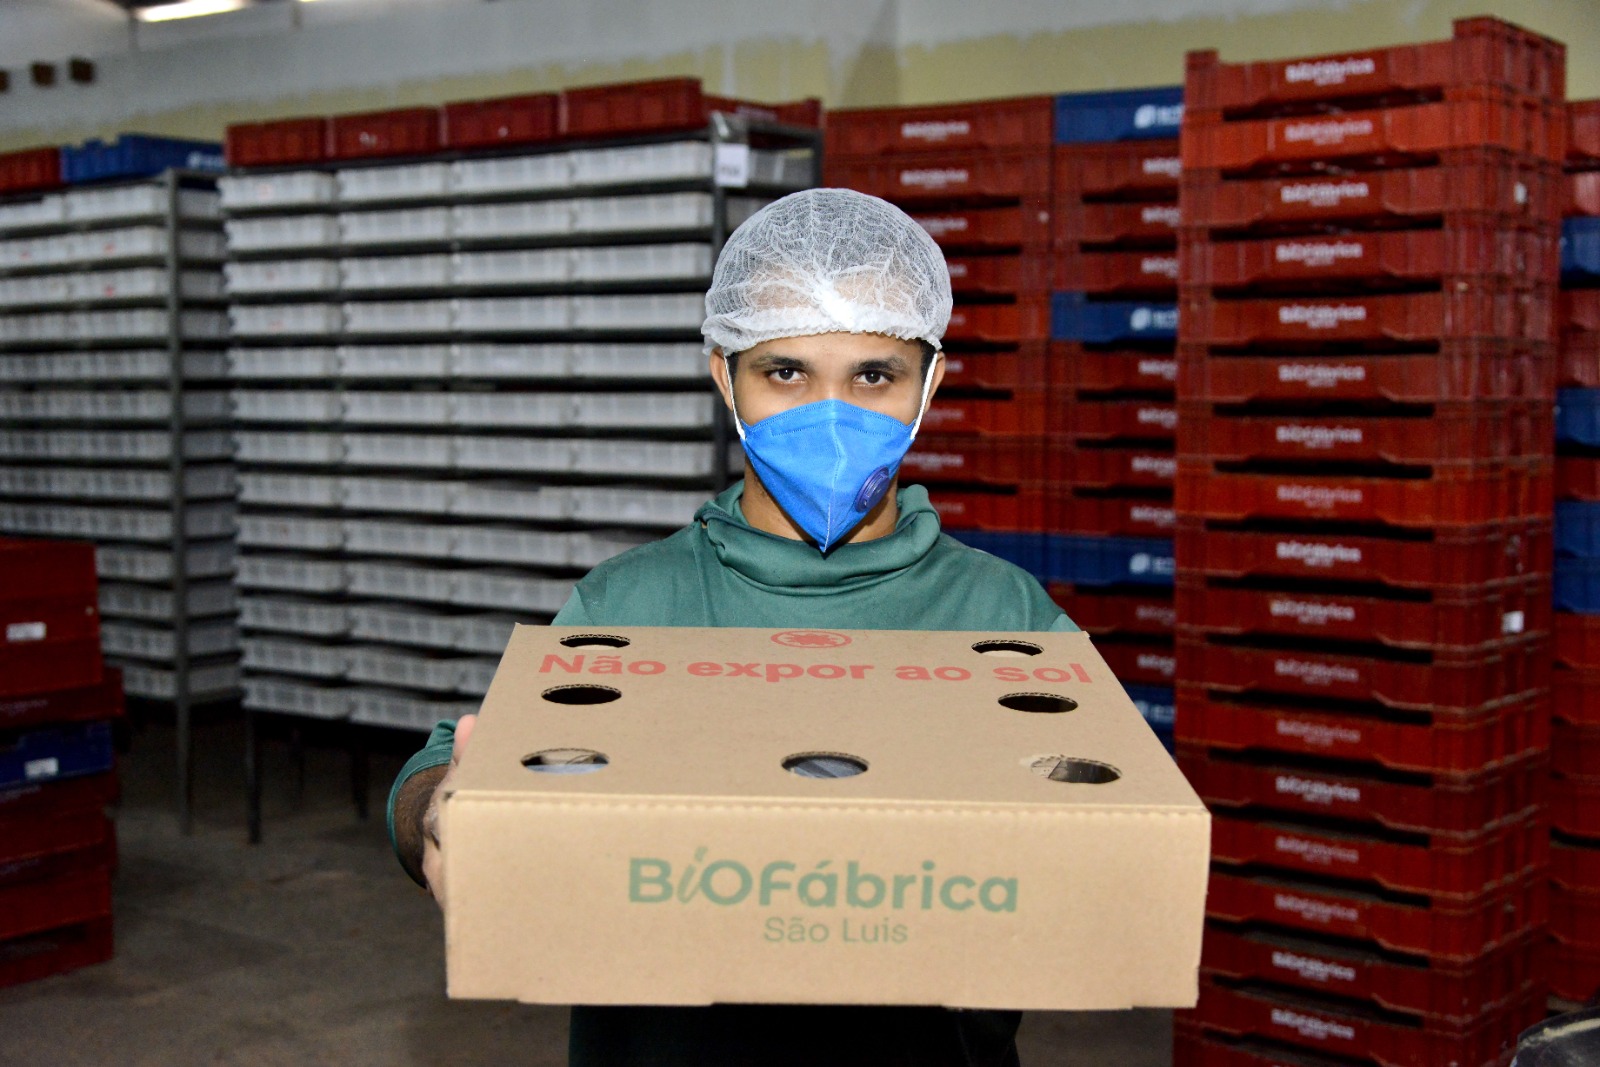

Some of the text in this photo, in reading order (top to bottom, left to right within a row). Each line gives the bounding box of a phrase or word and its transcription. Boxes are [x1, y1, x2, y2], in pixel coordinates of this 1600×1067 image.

[539, 654, 1092, 684] Não expor ao sol
[763, 916, 909, 944] São Luis
